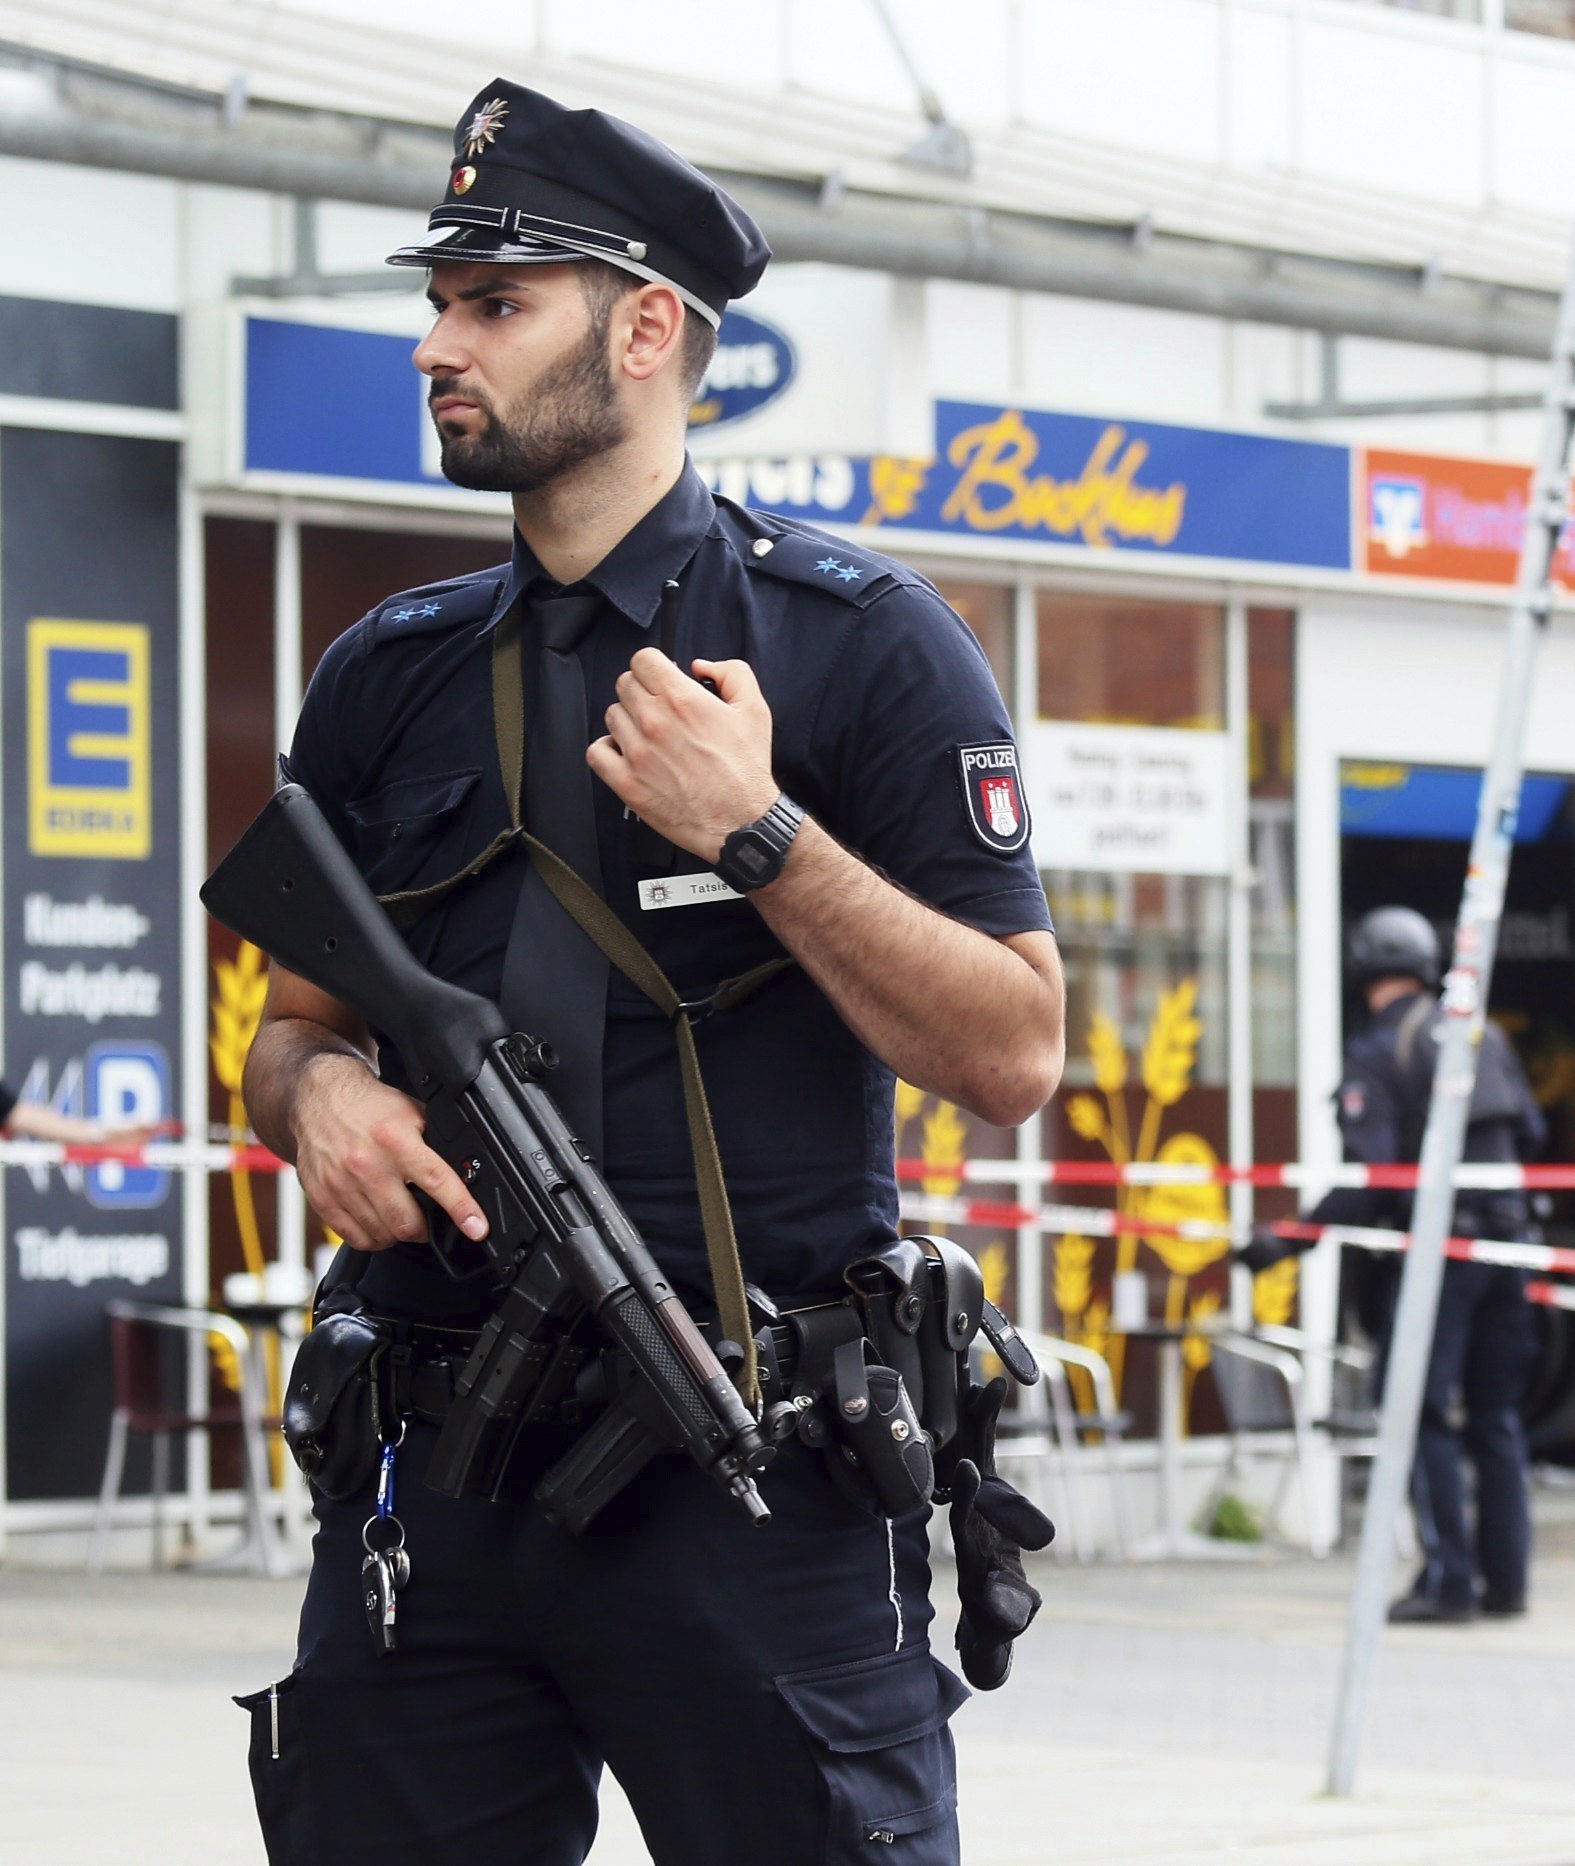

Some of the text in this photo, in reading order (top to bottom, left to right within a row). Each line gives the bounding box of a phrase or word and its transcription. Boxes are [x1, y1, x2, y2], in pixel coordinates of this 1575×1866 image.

[47, 648, 131, 790] E
[690, 881, 728, 894] Tatsis
[25, 892, 149, 948] Kunden-
[20, 960, 162, 1024] Parkplatz
[14, 1227, 170, 1287] Tiefgarage
